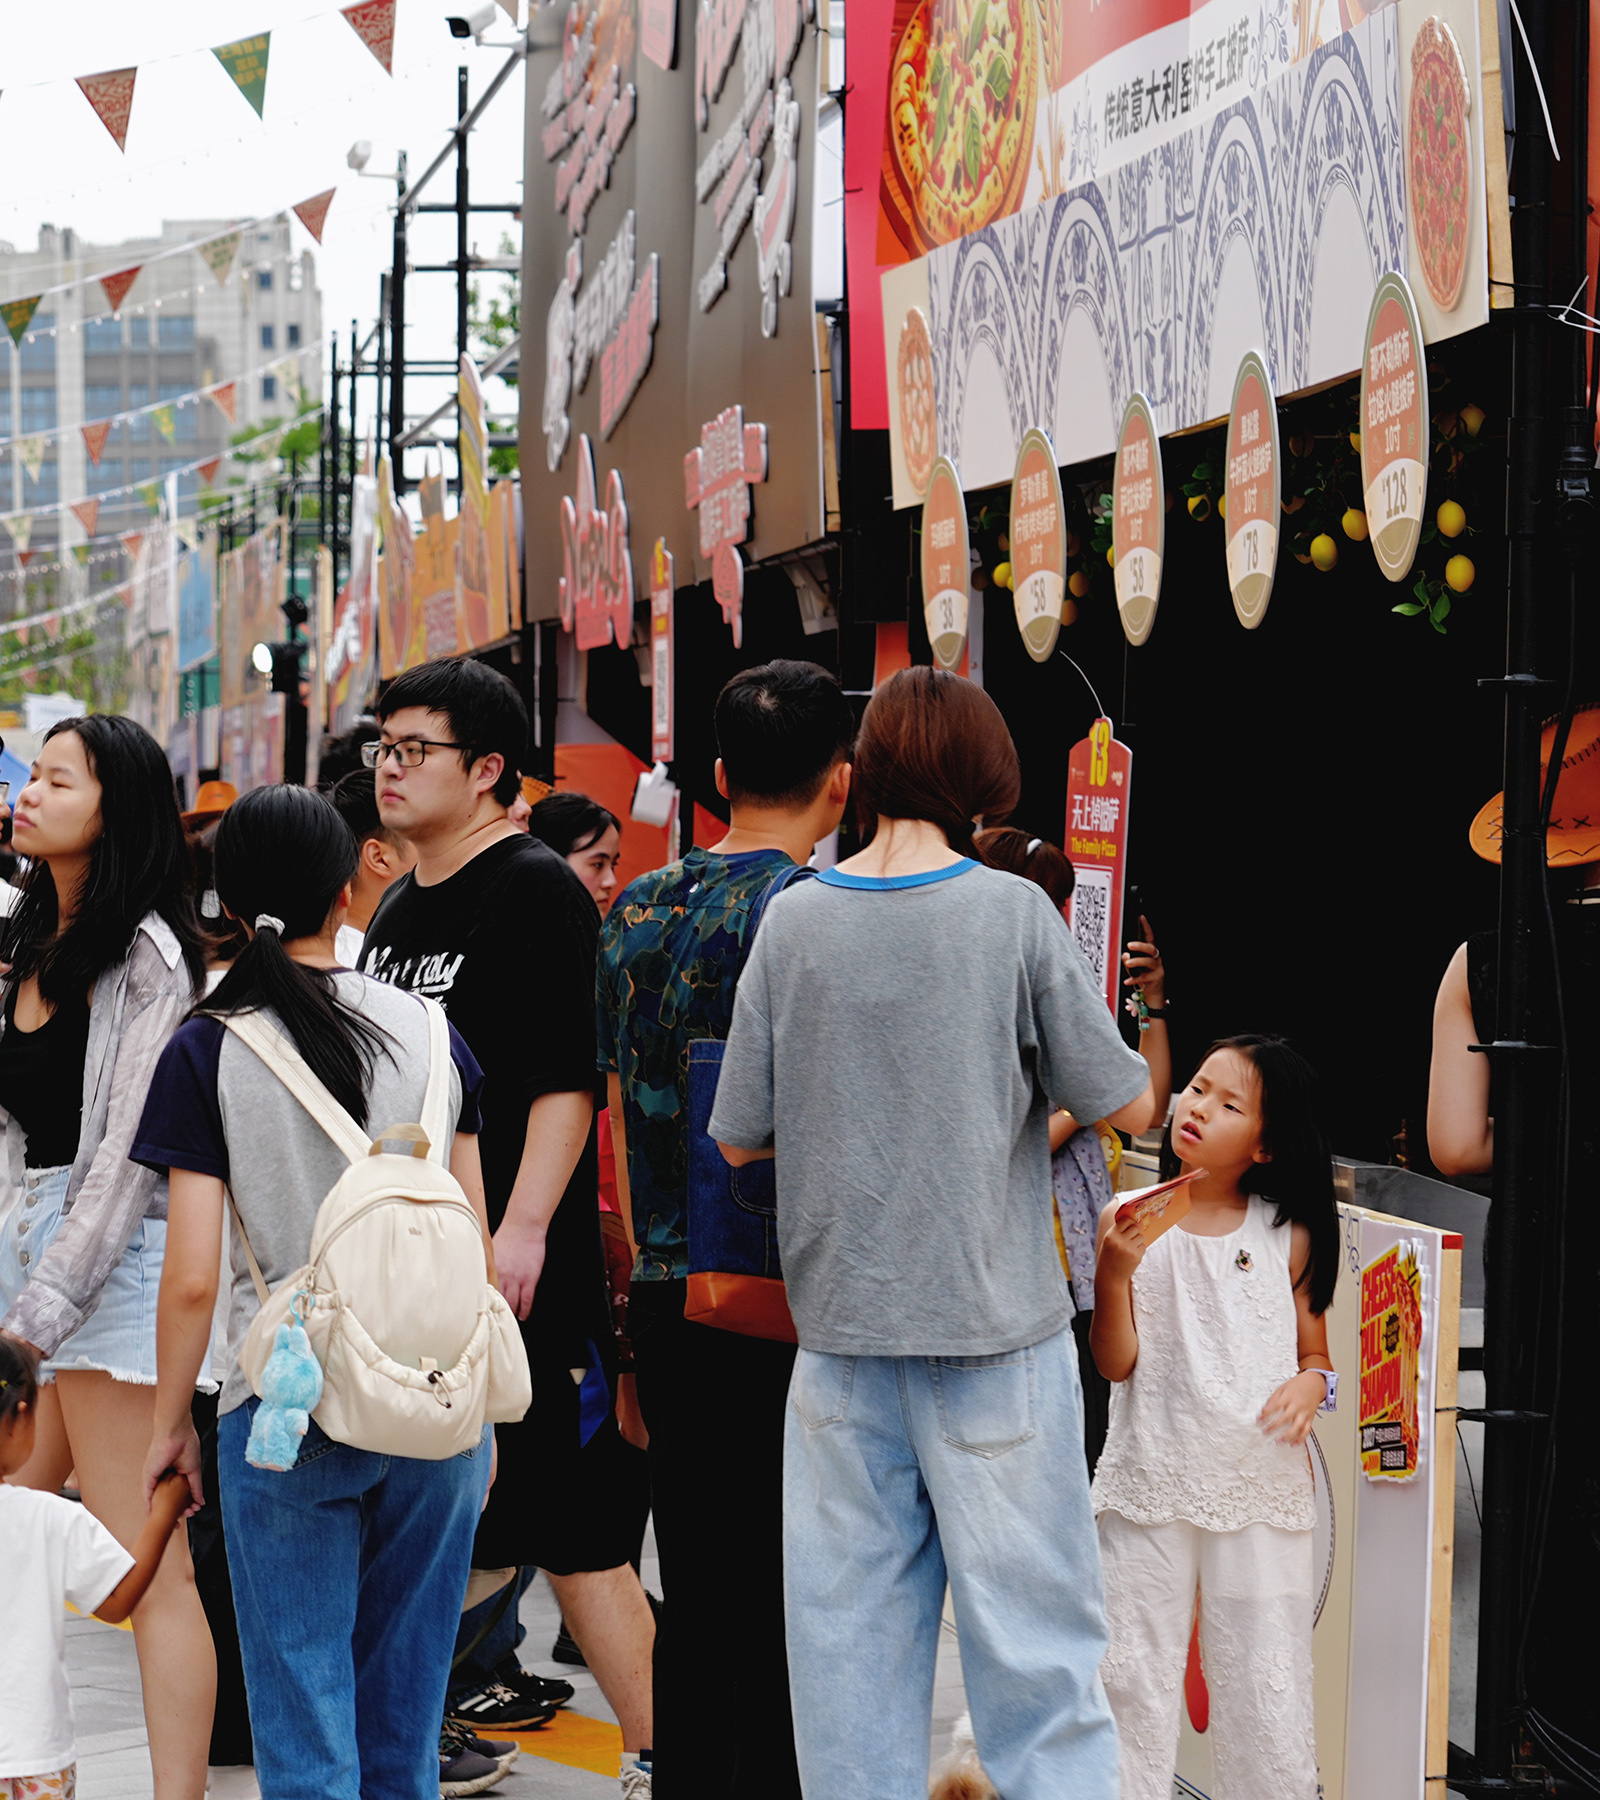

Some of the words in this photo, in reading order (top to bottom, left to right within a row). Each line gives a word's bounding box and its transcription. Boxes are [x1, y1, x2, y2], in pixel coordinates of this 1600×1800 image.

[1385, 421, 1401, 454] 10寸
[1243, 483, 1257, 515] 10寸
[1130, 515, 1143, 542] 10寸
[1089, 721, 1110, 787] 13
[1071, 794, 1120, 833] 天上掉披萨
[1071, 836, 1083, 854] The
[1082, 837, 1101, 859] Family
[1101, 838, 1117, 857] Pizza
[1361, 1251, 1398, 1324] CHEESE
[1361, 1316, 1383, 1375] PULL
